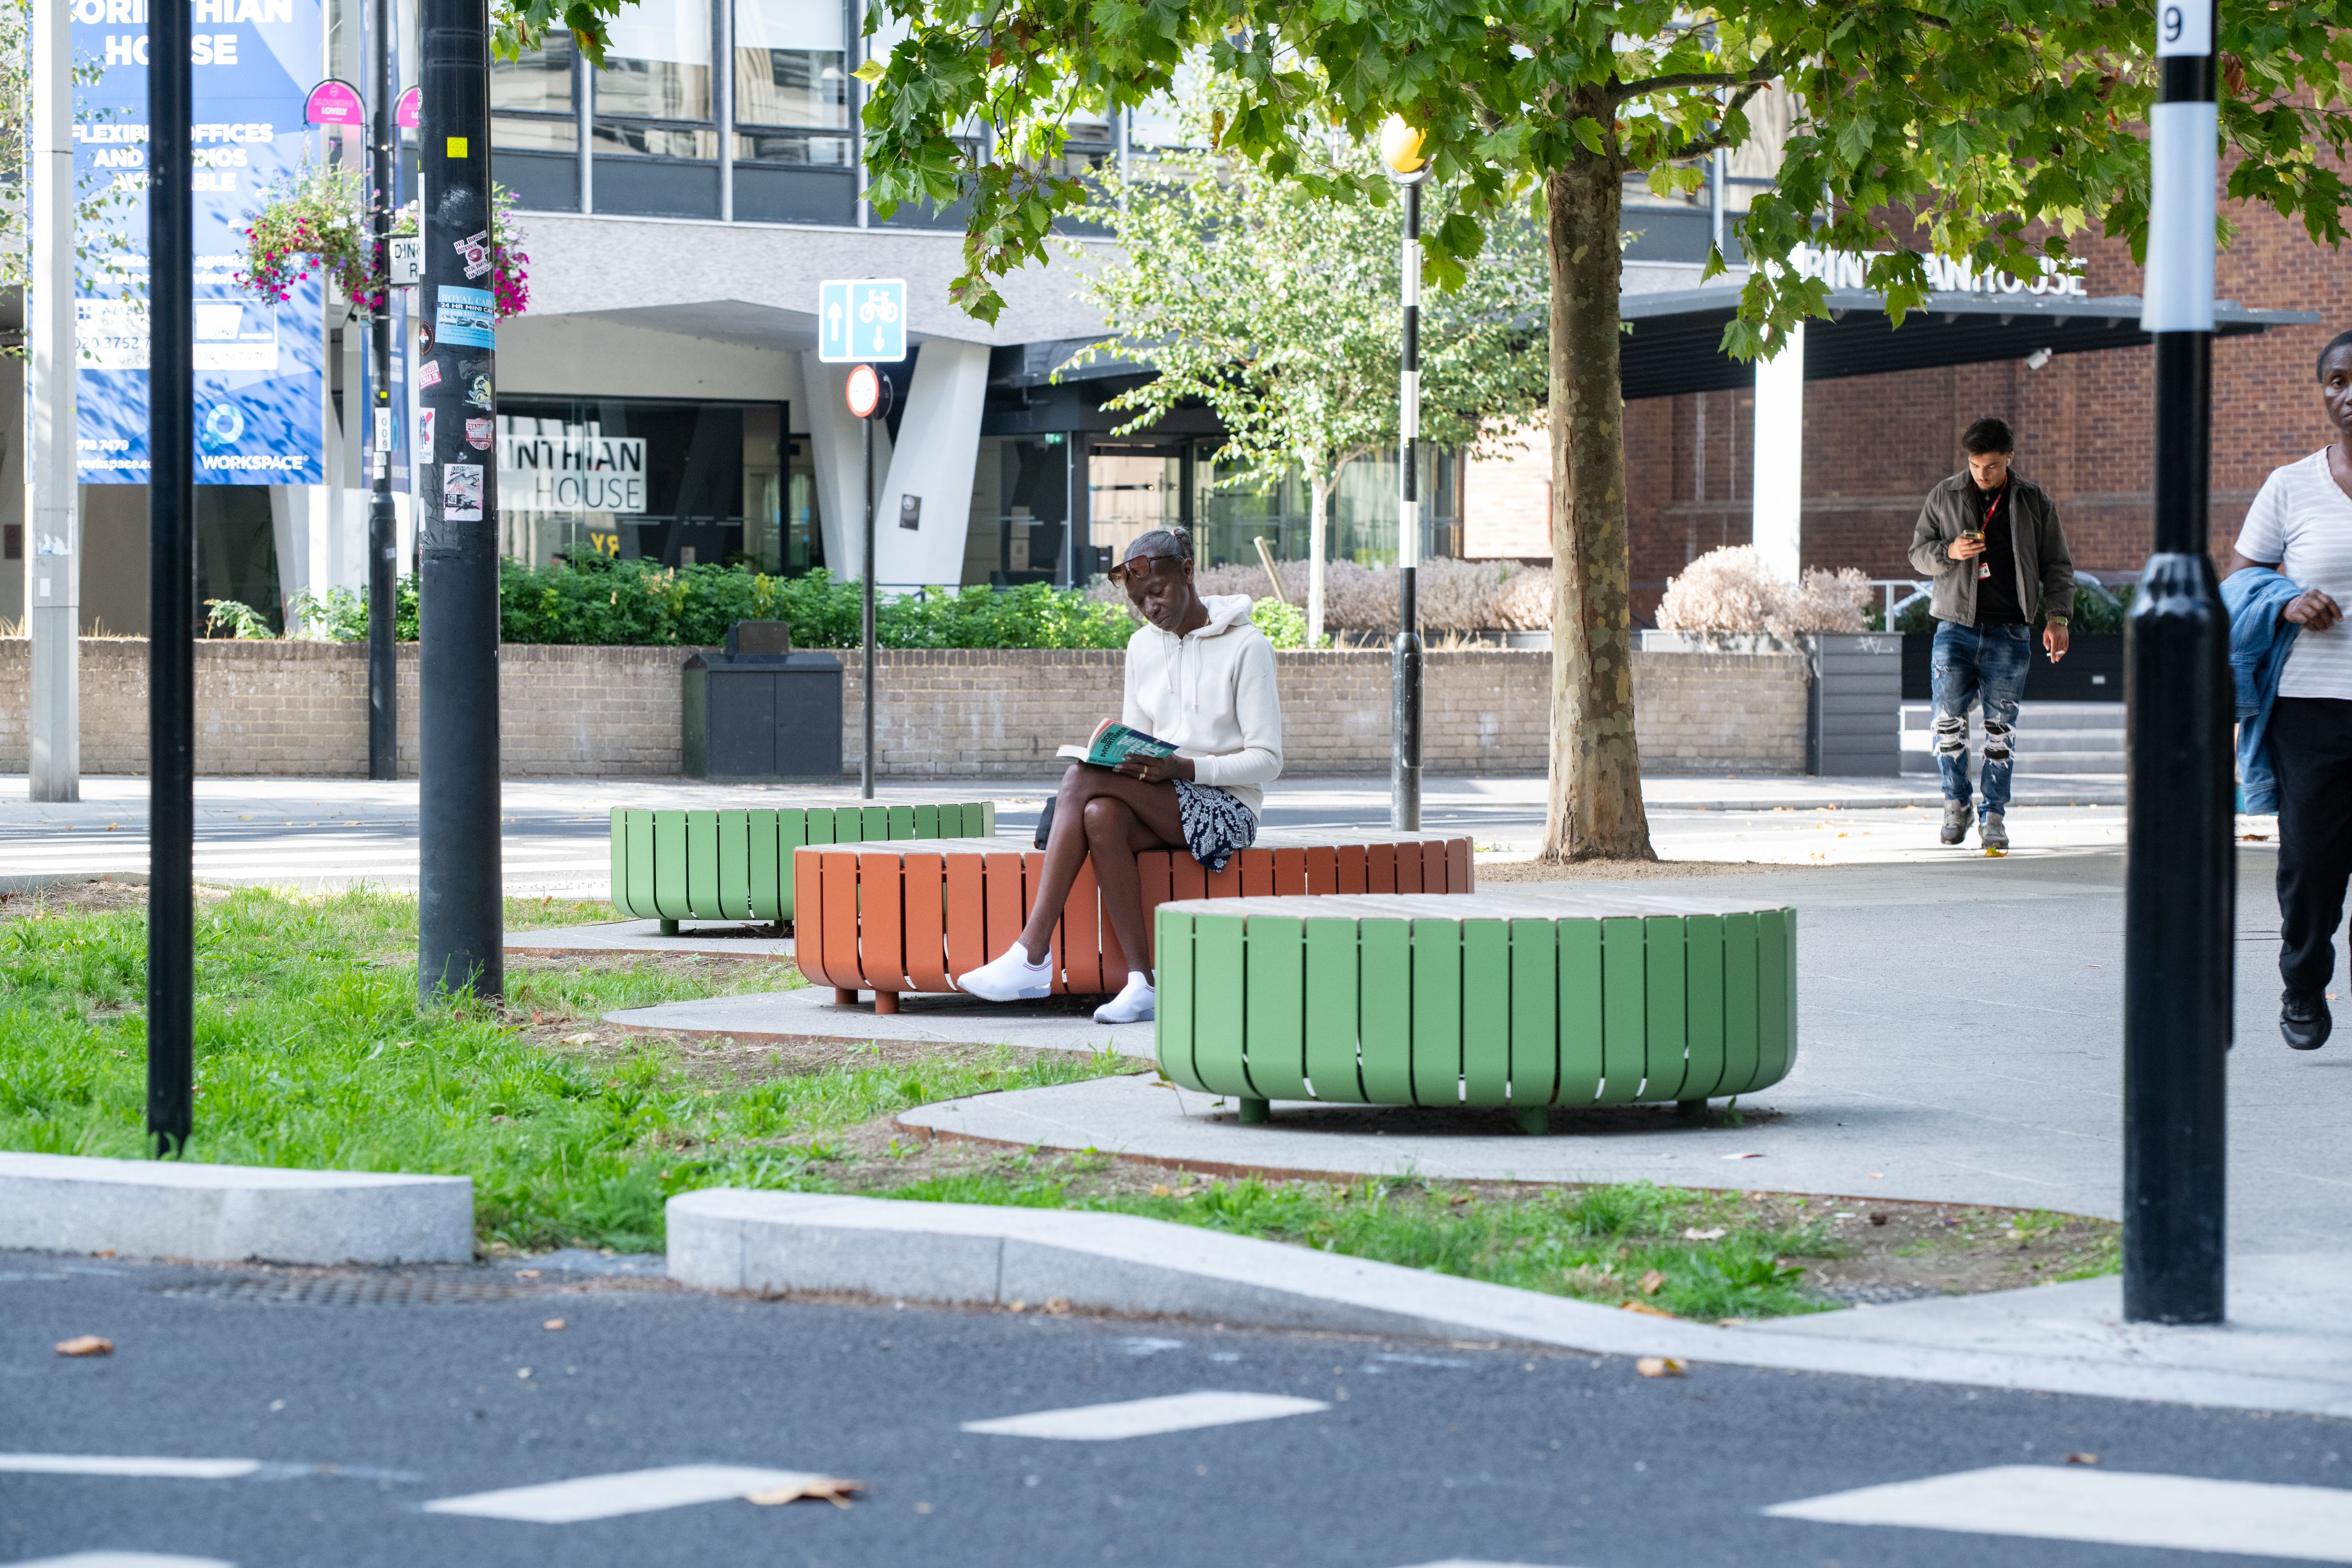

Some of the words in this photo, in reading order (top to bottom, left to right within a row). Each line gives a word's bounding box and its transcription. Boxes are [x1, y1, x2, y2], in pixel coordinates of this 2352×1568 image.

[2164, 6, 2182, 42] 9
[106, 34, 238, 65] HOSE
[321, 107, 348, 116] LOVELY
[93, 148, 144, 167] AND
[442, 294, 474, 304] ROYAL
[476, 297, 492, 307] CARS
[104, 337, 139, 349] 3752
[201, 455, 304, 470] WORKSPACE
[536, 477, 640, 509] HOUSE
[1100, 732, 1114, 744] BOB
[1100, 727, 1129, 757] MORTIMER
[1116, 735, 1137, 746] THE
